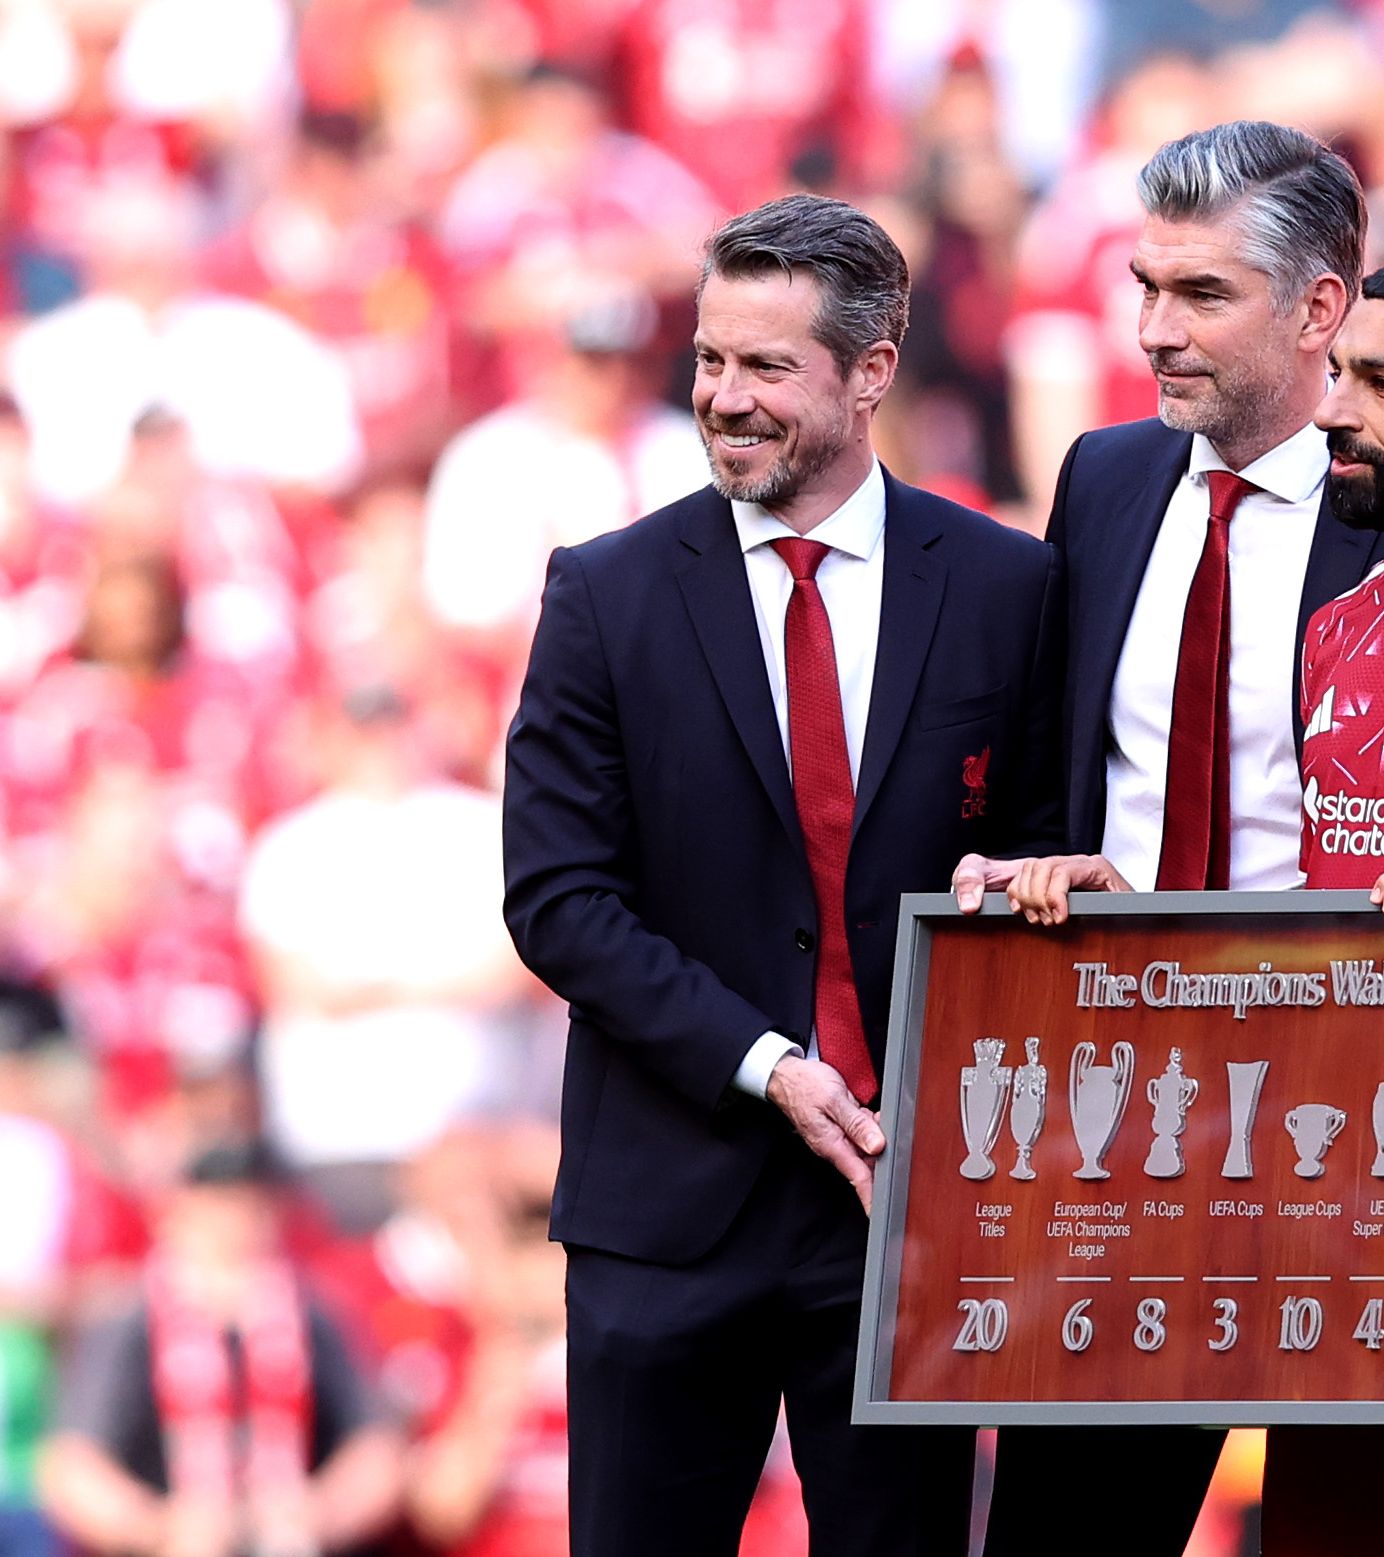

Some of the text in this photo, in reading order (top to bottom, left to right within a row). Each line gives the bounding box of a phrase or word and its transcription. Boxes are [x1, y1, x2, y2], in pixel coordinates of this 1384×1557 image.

[1073, 962, 1137, 1007] The
[1141, 961, 1326, 1019] Champions
[976, 1202, 1012, 1220] League
[1054, 1201, 1127, 1220] European Cup/
[1143, 1201, 1184, 1220] FA Cups
[1209, 1200, 1264, 1219] UEFA Cups
[1278, 1200, 1342, 1219] League Cups
[979, 1221, 1005, 1237] Titles
[1047, 1220, 1131, 1240] UEFA Champions
[1352, 1220, 1383, 1239] Super
[1068, 1241, 1105, 1260] League
[952, 1298, 1008, 1352] 20
[1061, 1298, 1093, 1352] 6
[1133, 1298, 1166, 1351] 8
[1208, 1298, 1239, 1351] 3
[1278, 1295, 1323, 1351] 10
